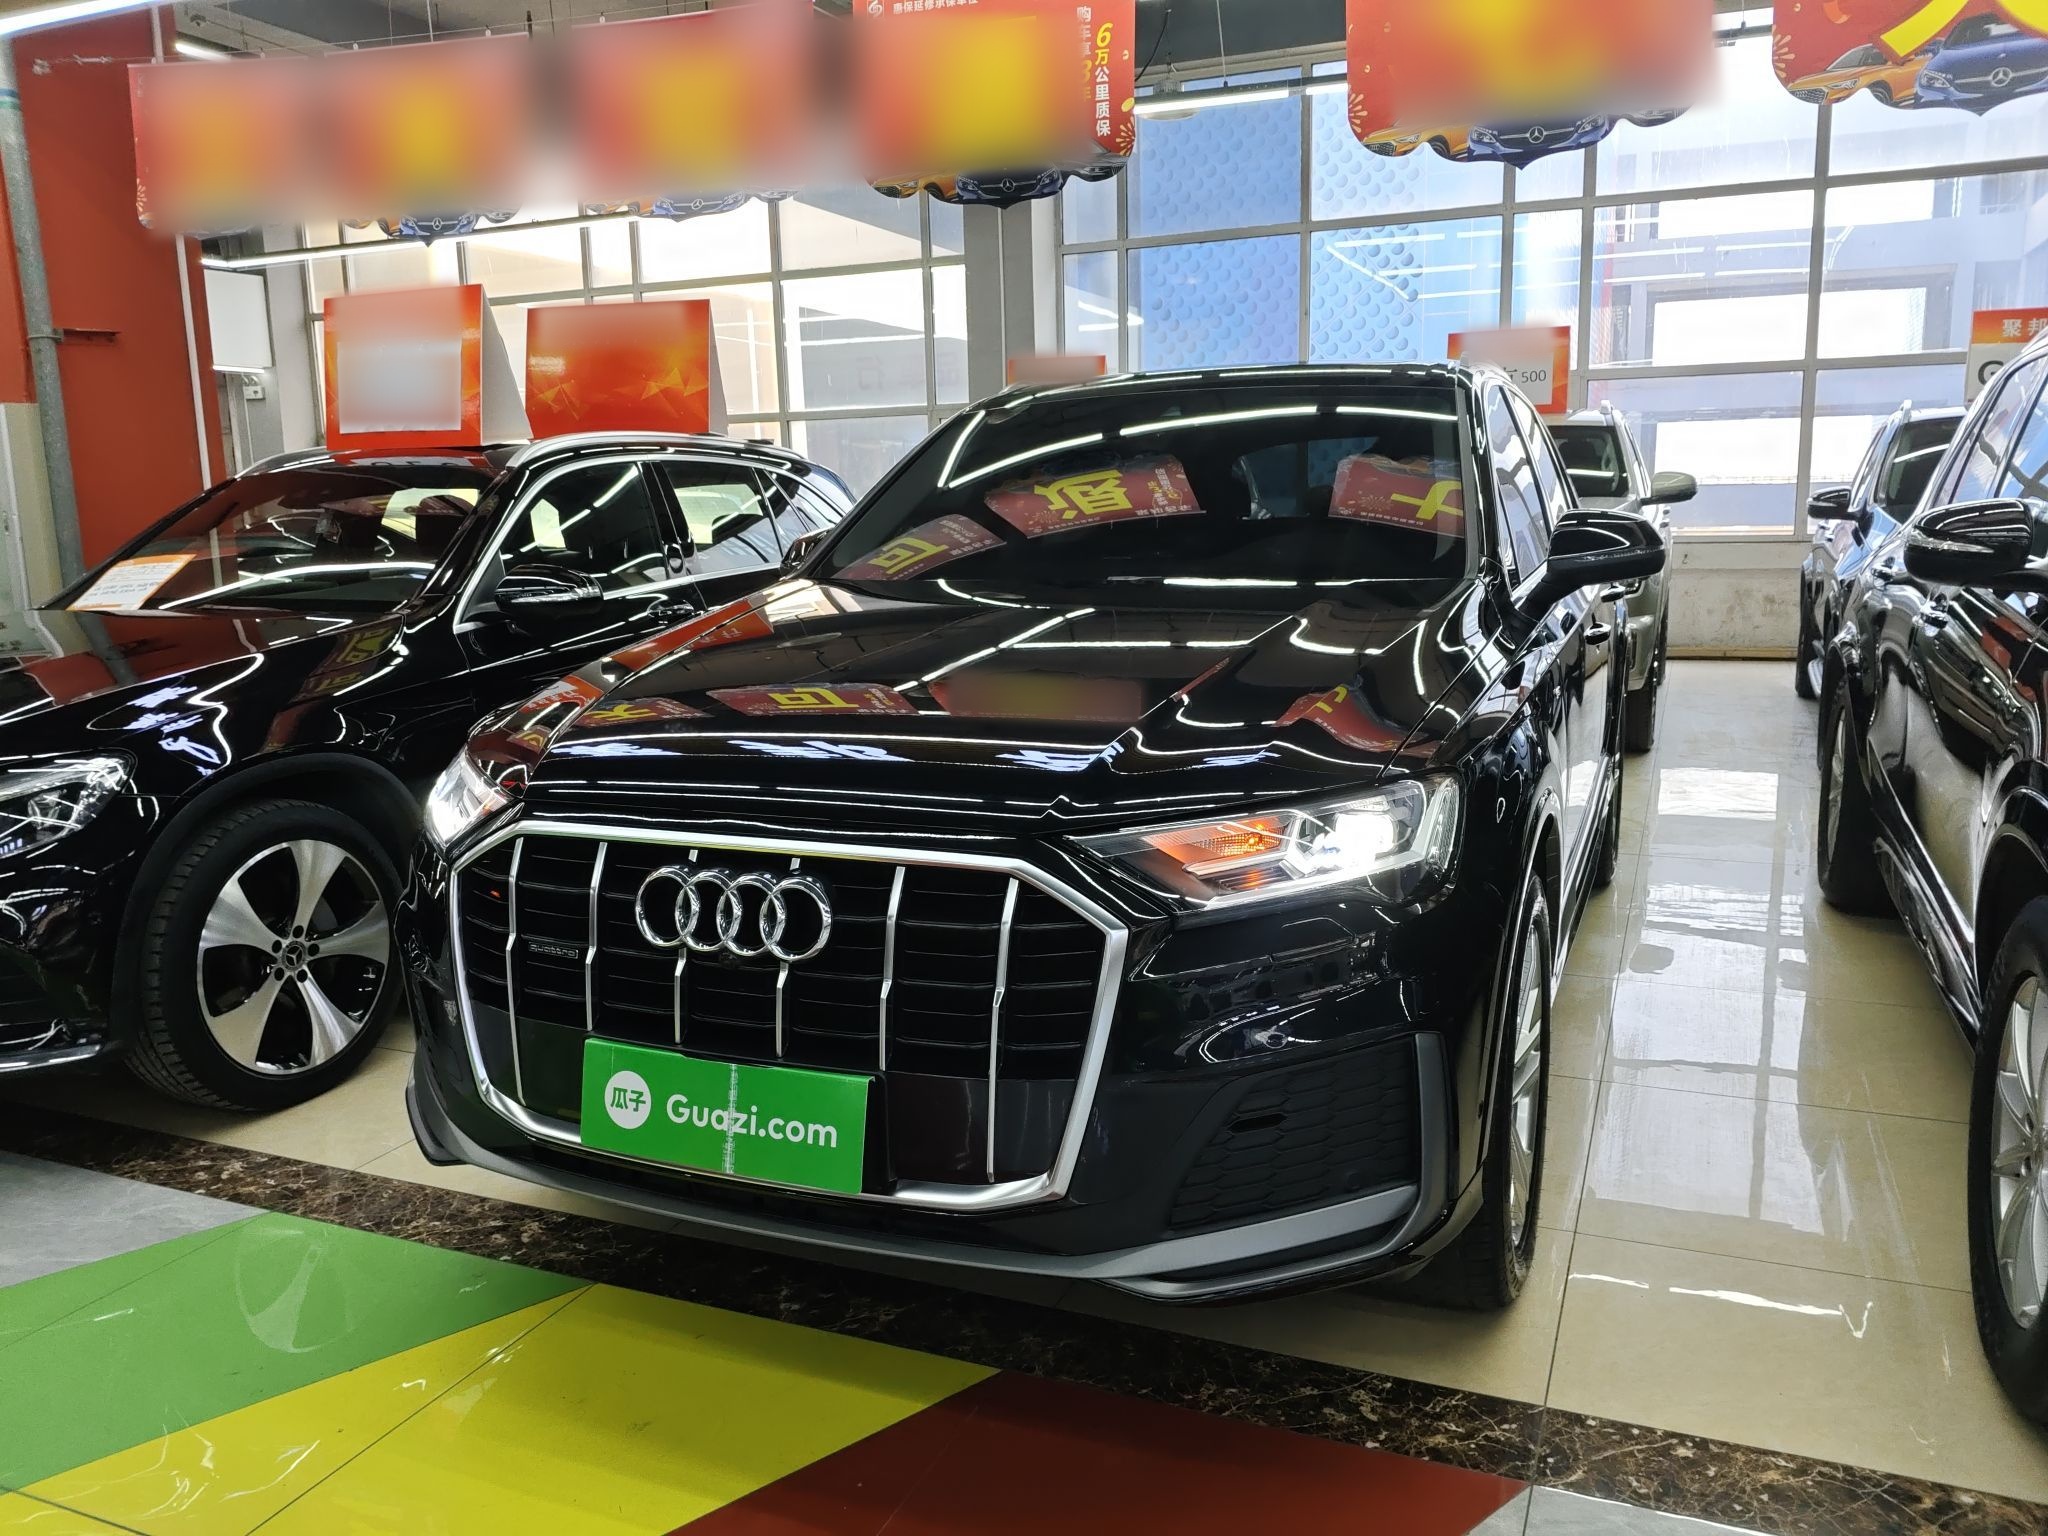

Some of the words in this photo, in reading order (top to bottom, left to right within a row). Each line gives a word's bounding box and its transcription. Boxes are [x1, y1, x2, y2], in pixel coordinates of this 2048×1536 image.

[1095, 21, 1113, 137] 6万公里质保
[1521, 369, 1547, 383] 500
[529, 943, 576, 957] quattro
[610, 1086, 646, 1112] 瓜子
[666, 1094, 838, 1148] Guazi.com
